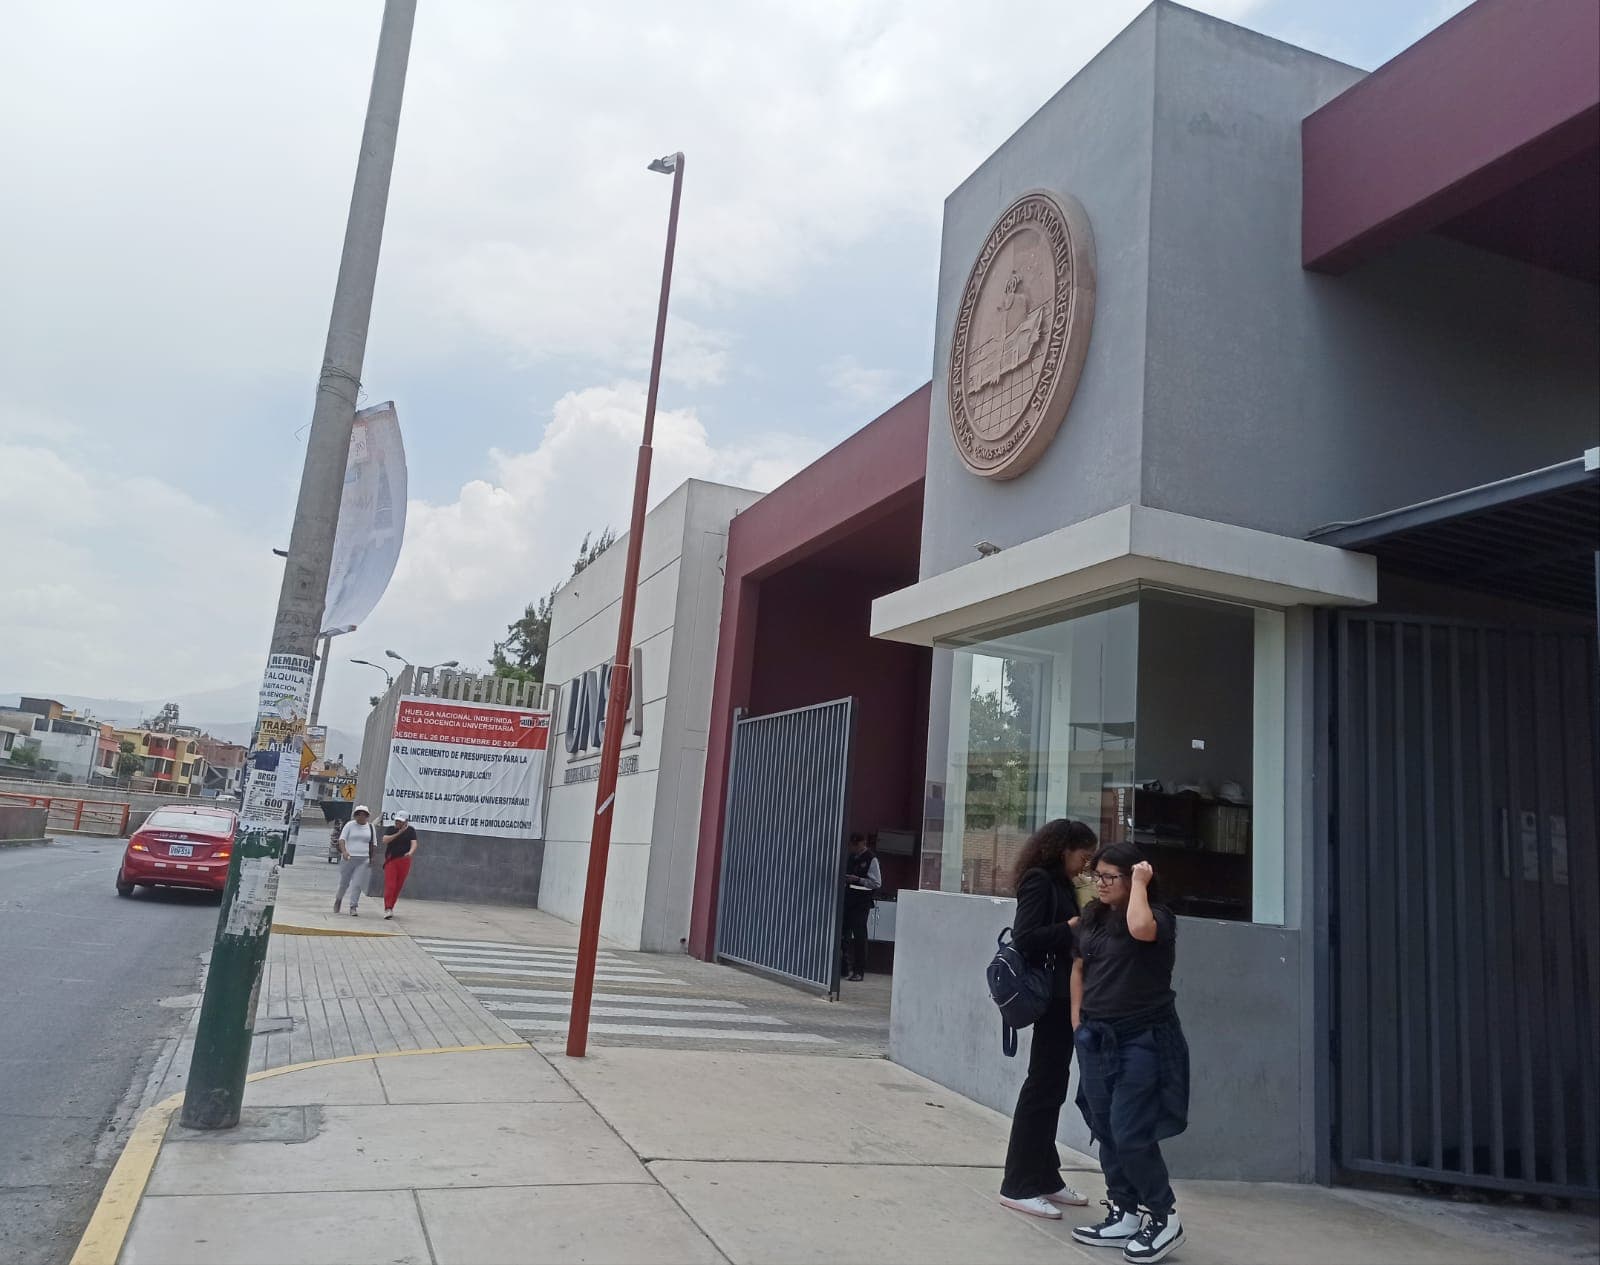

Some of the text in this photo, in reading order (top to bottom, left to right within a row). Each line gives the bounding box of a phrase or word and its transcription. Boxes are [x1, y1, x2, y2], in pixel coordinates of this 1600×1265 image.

[268, 671, 305, 684] ALQUILA
[405, 708, 434, 717] HUELGA
[436, 711, 472, 720] NACIONAL
[474, 715, 512, 724] INDEFINIDA
[424, 718, 460, 728] DOCENCIA
[462, 721, 514, 732] UNIVERSITARIA
[394, 730, 418, 738] DESDE
[451, 736, 491, 745] SETIEMBRE
[401, 746, 408, 754] EL
[410, 747, 449, 758] INCREMENTO
[451, 751, 459, 759] DE
[460, 751, 503, 763] PRESUPUESTO
[503, 755, 518, 763] PARA
[519, 756, 528, 764] LA
[419, 767, 459, 778] UNIVERSIDAD
[396, 789, 424, 799] DEFENSA
[425, 792, 434, 800] DE
[435, 793, 443, 801] LA
[264, 798, 282, 808] 600
[391, 813, 437, 824] CLIMIENTO
[439, 816, 446, 825] DE
[448, 817, 456, 825] LA
[458, 817, 469, 826] LEY
[471, 818, 479, 827] DE
